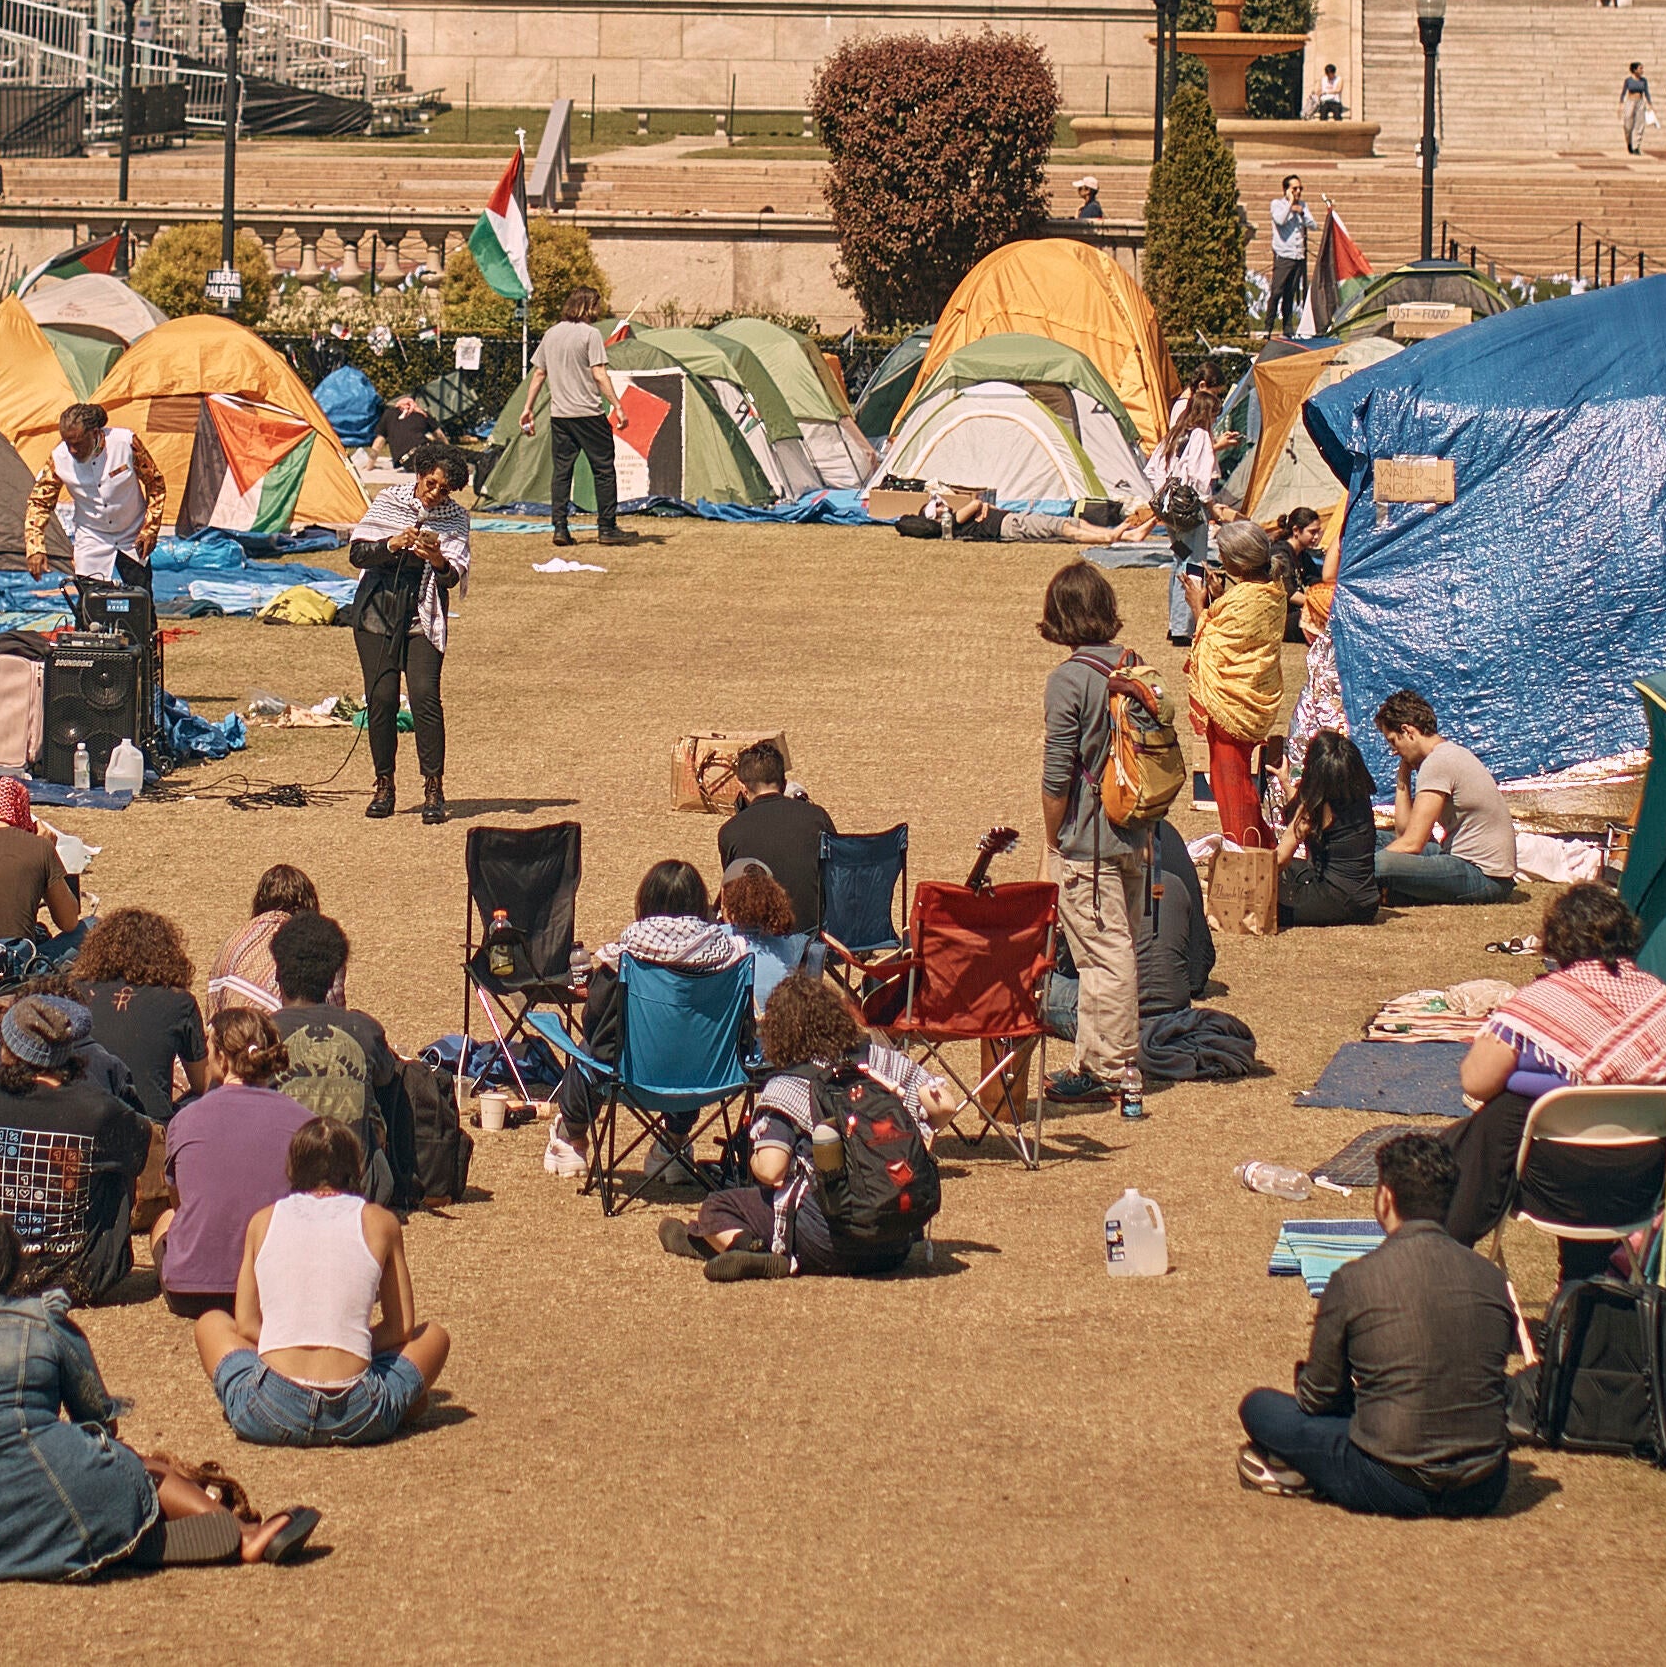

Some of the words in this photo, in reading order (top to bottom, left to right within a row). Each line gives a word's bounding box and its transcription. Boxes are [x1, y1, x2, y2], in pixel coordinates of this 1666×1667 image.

[1388, 307, 1411, 320] LOST
[1422, 308, 1451, 321] FOUND
[1377, 463, 1424, 480] WALID
[54, 658, 95, 668] SOUNDBOKS
